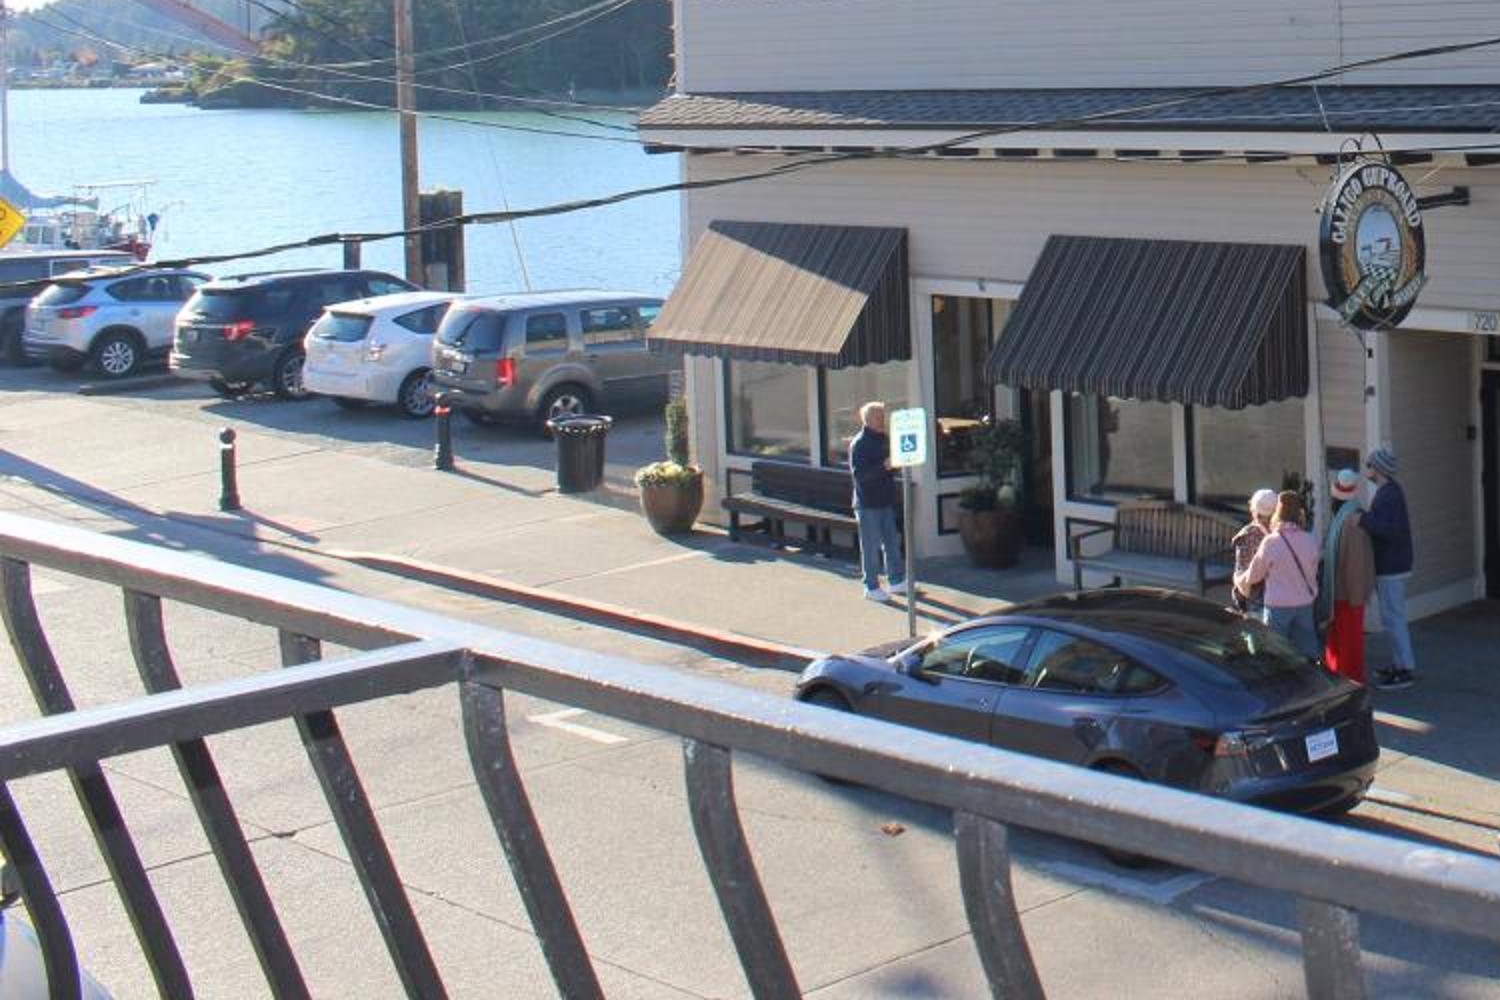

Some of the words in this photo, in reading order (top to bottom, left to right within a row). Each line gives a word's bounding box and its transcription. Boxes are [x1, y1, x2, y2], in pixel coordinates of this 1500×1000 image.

[1331, 177, 1363, 244] CALICO
[1361, 167, 1421, 227] CUPBOARD
[1474, 311, 1498, 331] 720
